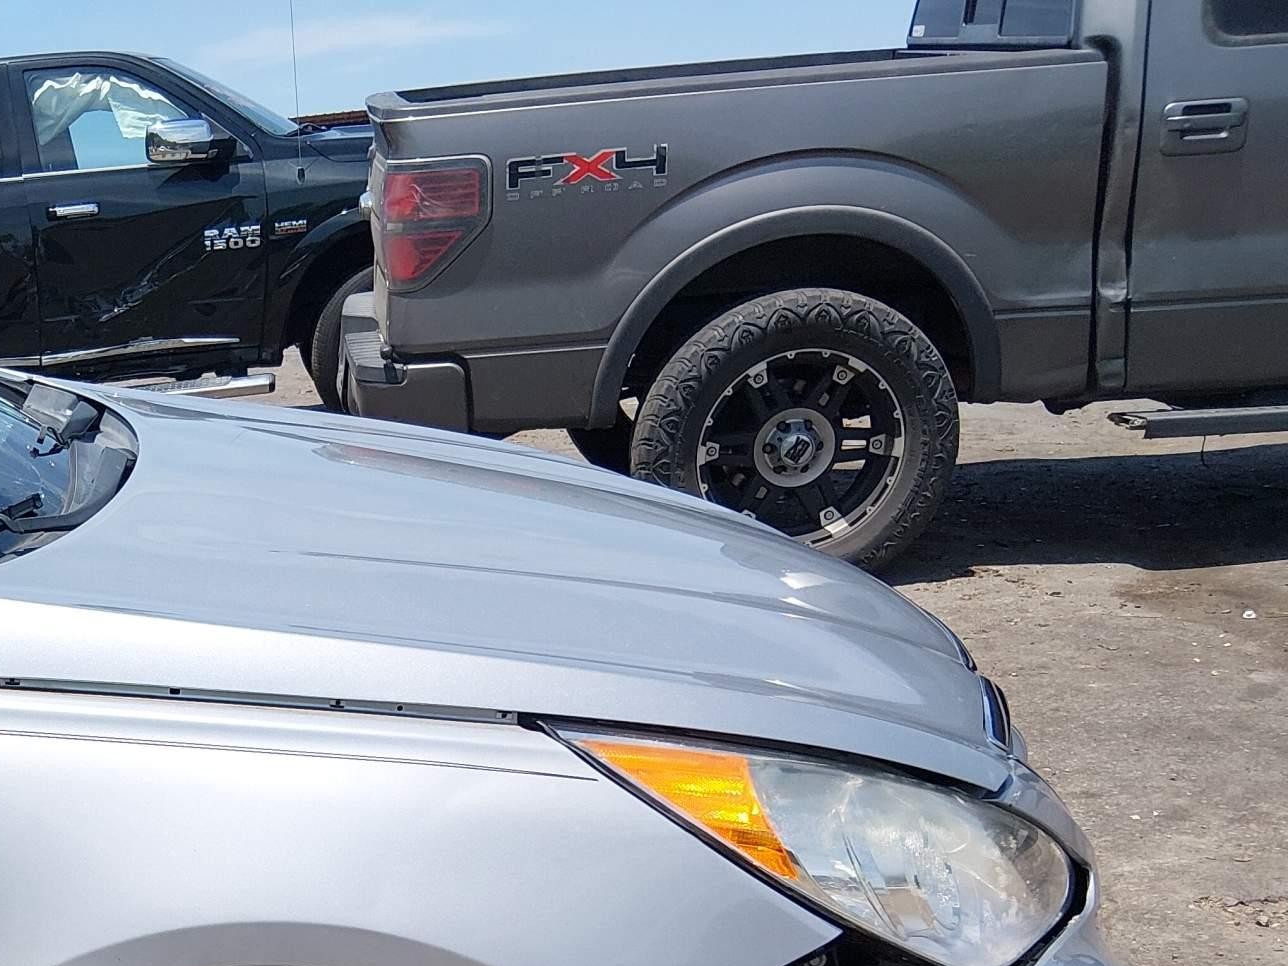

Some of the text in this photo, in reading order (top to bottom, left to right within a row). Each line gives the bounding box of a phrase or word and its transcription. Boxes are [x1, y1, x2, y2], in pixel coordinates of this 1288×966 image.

[506, 143, 668, 190] FX4
[204, 224, 261, 240] RAM
[204, 237, 261, 251] 1500
